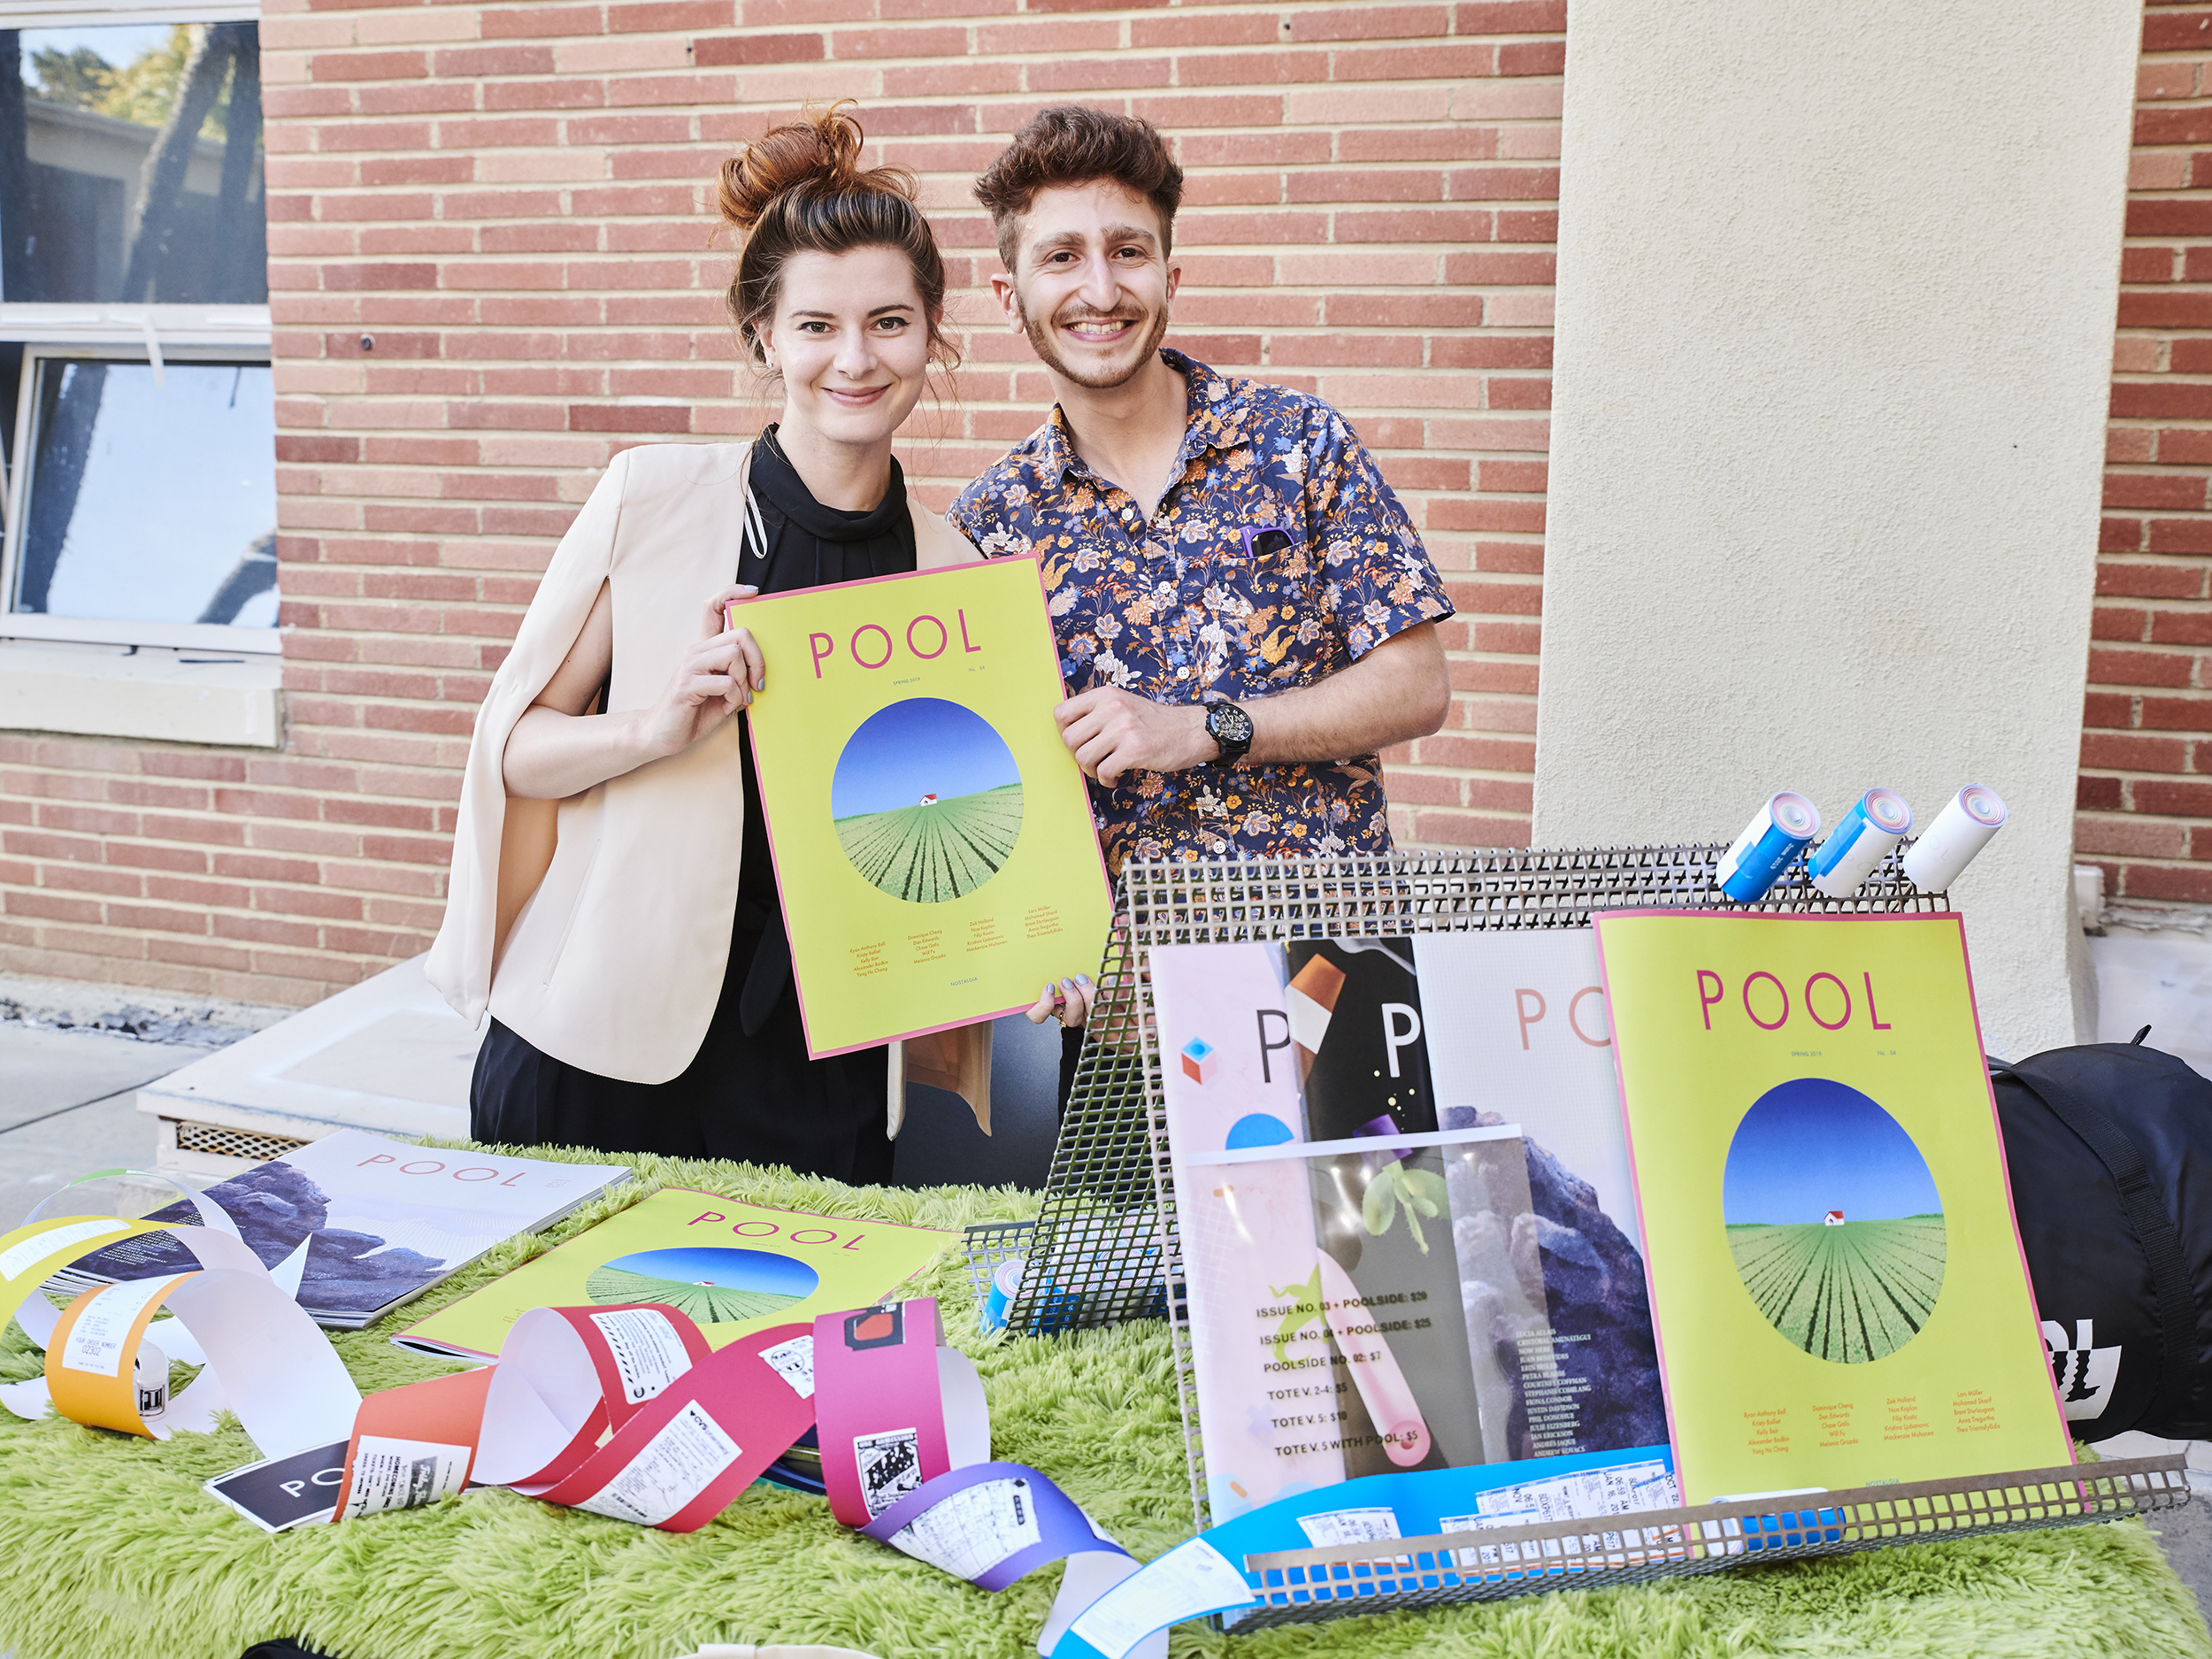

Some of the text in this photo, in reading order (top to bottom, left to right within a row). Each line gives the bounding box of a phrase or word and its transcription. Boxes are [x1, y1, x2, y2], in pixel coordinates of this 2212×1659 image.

[809, 609, 981, 679] POOL
[949, 976, 979, 987] NOSTALGIA
[1696, 970, 1892, 1030] POOL
[1256, 1010, 1291, 1084] P
[1381, 1002, 1421, 1078] P
[357, 1154, 526, 1187] POOL
[687, 1211, 865, 1250] POOL
[1256, 1305, 1294, 1317] ISSUE
[1296, 1302, 1317, 1314] NO.
[1319, 1302, 1331, 1311] 03
[1343, 1293, 1408, 1309] POOLSIDE:
[1261, 1333, 1296, 1345] ISSUE
[1300, 1330, 1320, 1341] NO.
[1347, 1319, 1411, 1336] POOLSIDE:
[1414, 1317, 1432, 1329] $25
[82, 1345, 101, 1356] 02302
[1263, 1351, 1381, 1372] POOLSIDE NO. 02: $7
[1268, 1382, 1348, 1401] TOTE V. 2-4: $5
[1548, 1403, 1580, 1412] DAVIDSON
[1271, 1410, 1348, 1428] TOTE V. 5: $10
[694, 1416, 729, 1455] CVS pharmacy
[1275, 1431, 1418, 1456] TOTE V. 5 WITH POOL: $5
[388, 1456, 401, 1495] HOMECOMING
[1603, 1471, 1613, 1486] JAN
[1665, 1474, 1676, 1490] OCT
[1865, 1479, 1900, 1487] NOSTALGIA
[1512, 1488, 1523, 1502] NOV
[1621, 1500, 1629, 1510] AM
